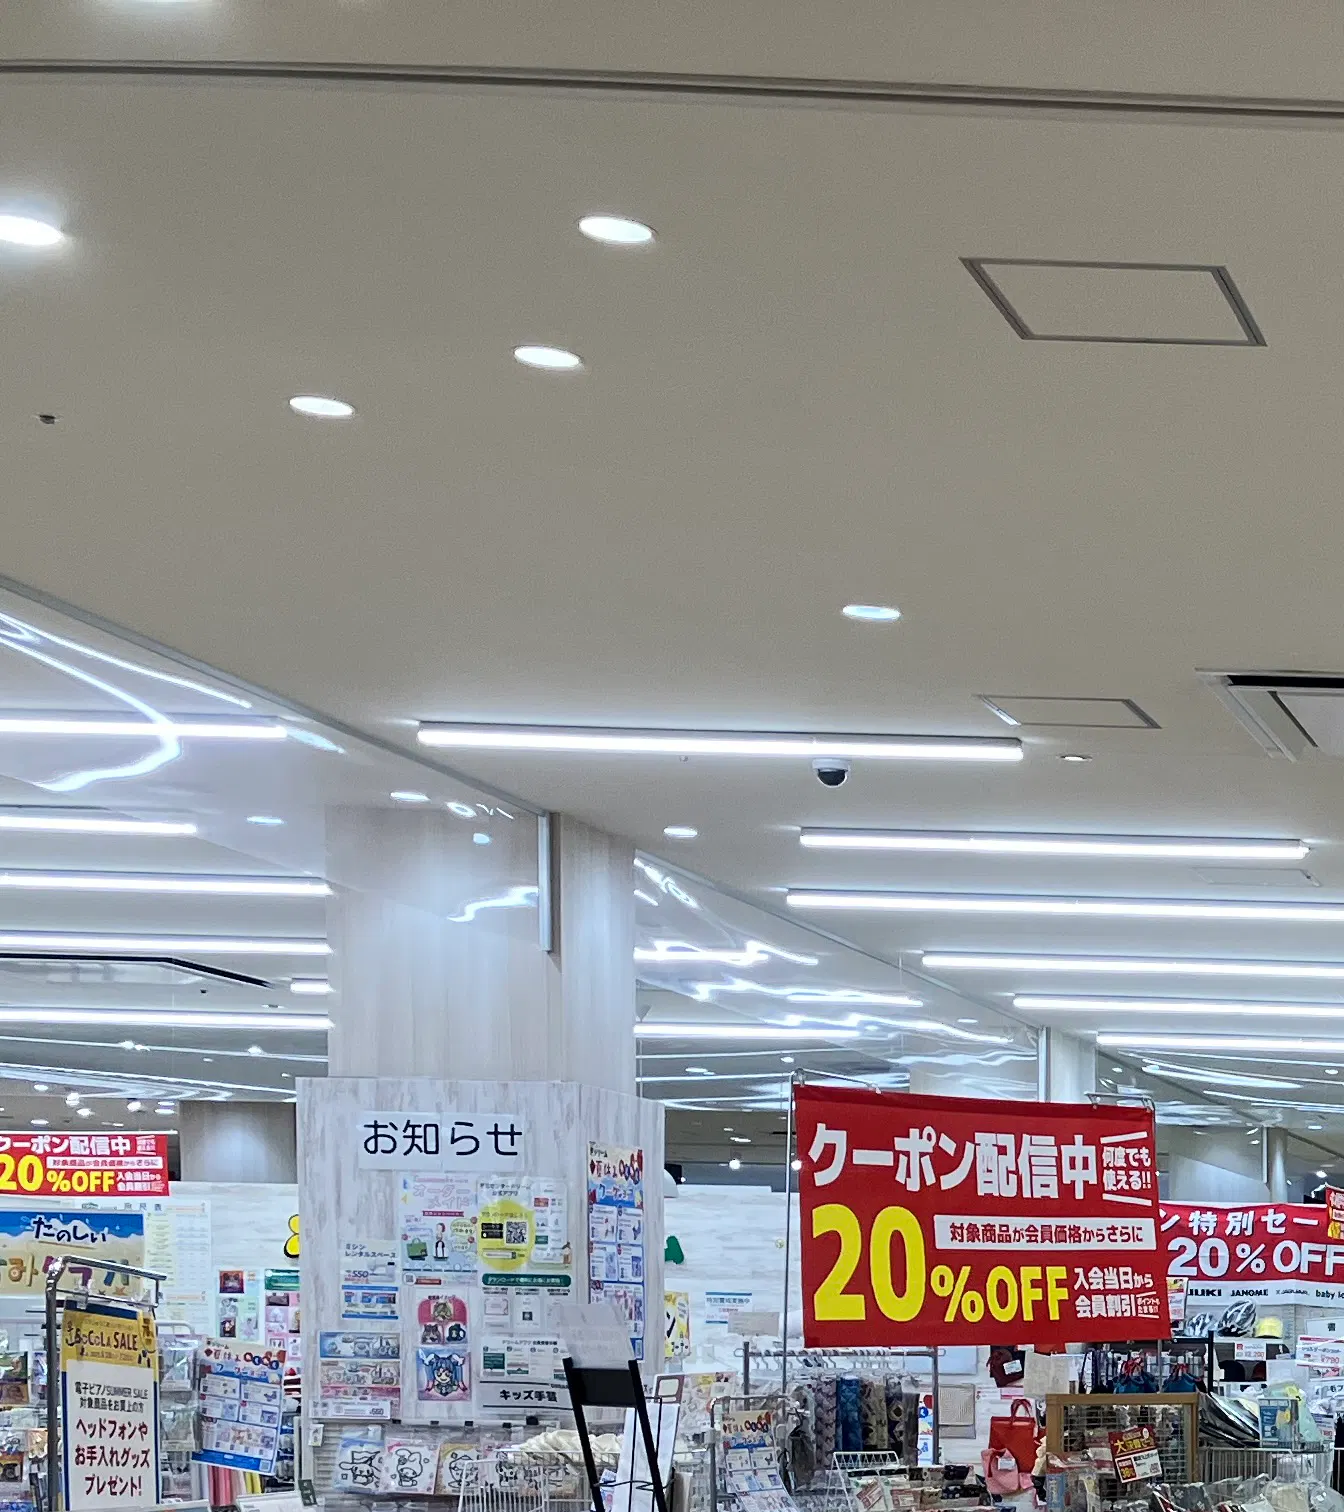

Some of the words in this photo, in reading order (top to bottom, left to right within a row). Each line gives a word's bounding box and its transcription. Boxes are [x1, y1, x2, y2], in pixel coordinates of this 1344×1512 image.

[363, 1119, 523, 1156] お知らせ
[807, 1122, 1098, 1200] クーポン配信中
[1102, 1145, 1151, 1169] 何度でも
[32, 1216, 107, 1243] たのしい
[949, 1222, 1143, 1244] 対象商品が会員価格からさらに
[1073, 1266, 1154, 1290] 入会当日から
[1075, 1294, 1136, 1318] 会員割引
[1230, 1288, 1269, 1297] JANOME
[1315, 1289, 1335, 1300] baby
[113, 1331, 139, 1351] SALE
[76, 1417, 149, 1441] ヘッドフォンや
[75, 1445, 151, 1469] お手入れグッズ
[84, 1475, 143, 1498] プレゼント!
